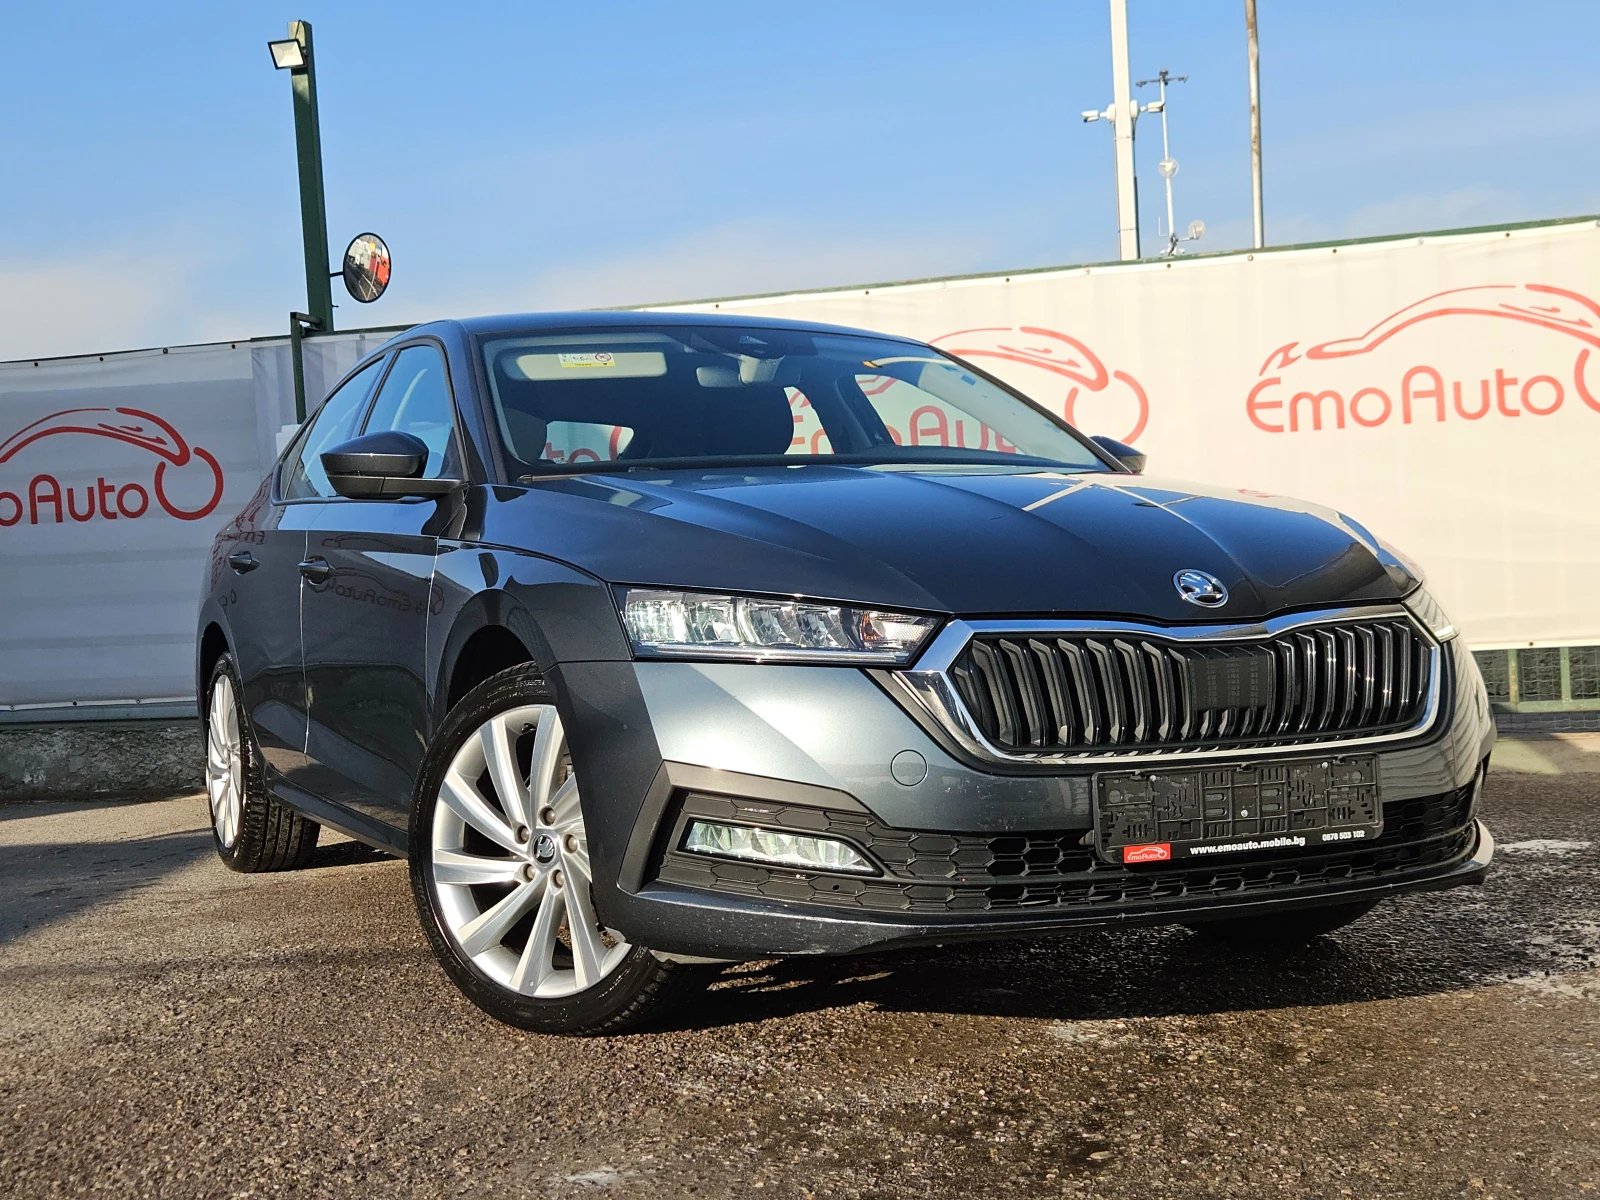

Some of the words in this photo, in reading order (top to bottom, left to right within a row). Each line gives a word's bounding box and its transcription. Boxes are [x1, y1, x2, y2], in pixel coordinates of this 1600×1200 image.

[1246, 365, 1565, 433] EmoAuto
[1190, 836, 1306, 855] www.emoauto.mobile.bg
[1339, 831, 1352, 840] 503
[1353, 830, 1366, 838] 102
[1127, 853, 1158, 861] EmoAuto
